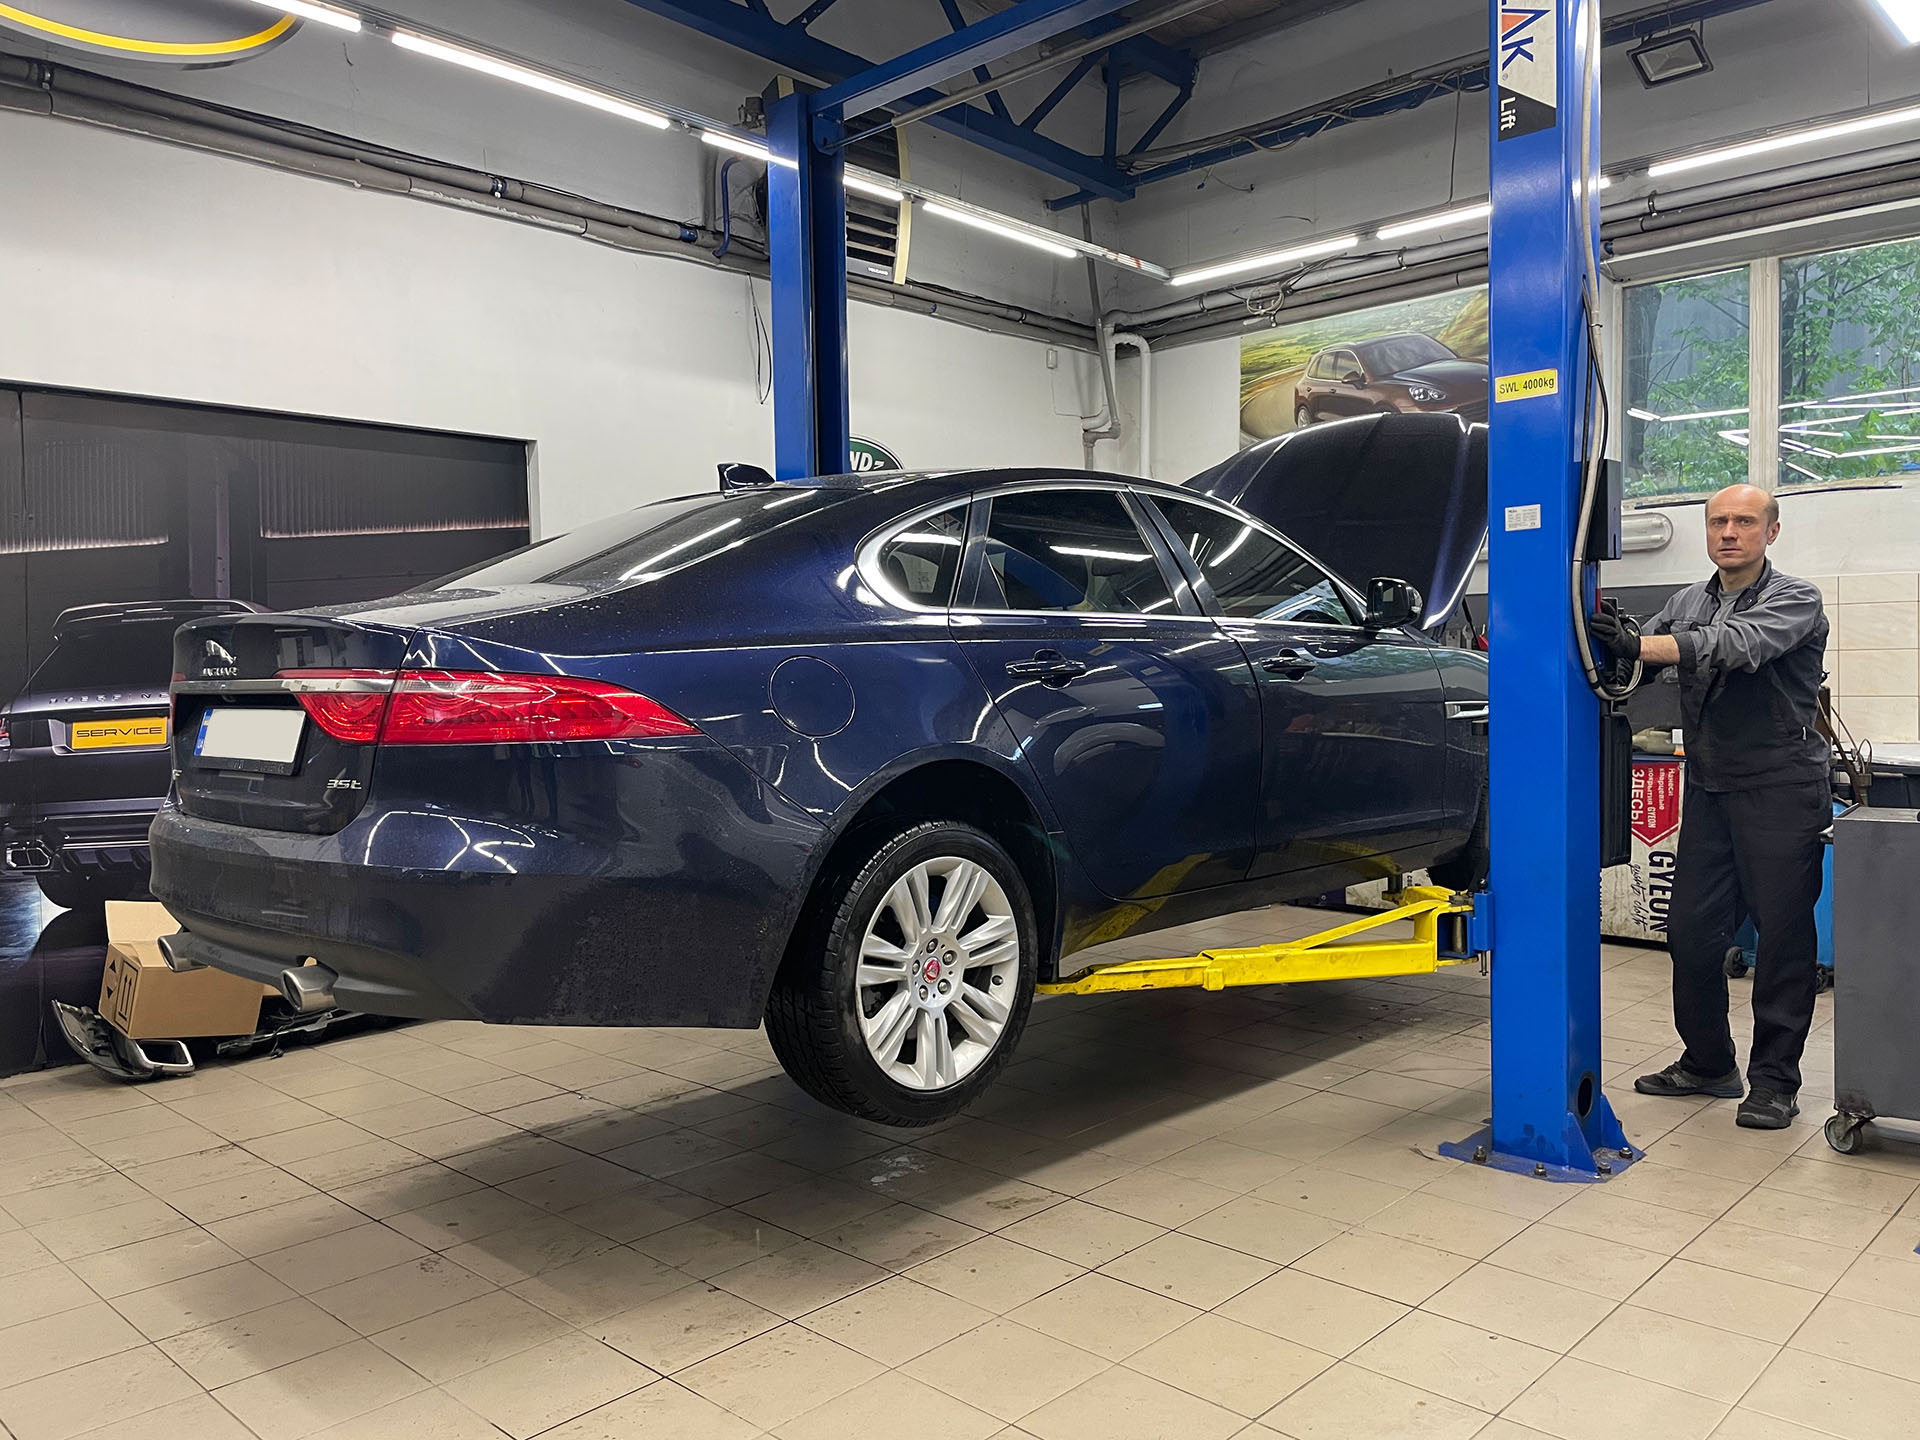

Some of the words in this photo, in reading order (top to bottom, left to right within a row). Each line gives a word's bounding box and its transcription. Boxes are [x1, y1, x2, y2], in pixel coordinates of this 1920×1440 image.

[1501, 0, 1551, 72] AK
[1500, 96, 1516, 131] Lift
[1499, 382, 1519, 394] SWL
[1523, 377, 1554, 390] 4000kg
[76, 727, 162, 737] SERVICE
[327, 779, 362, 789] 35t
[1632, 769, 1645, 825] ЗДЕСЬ!
[1647, 806, 1656, 829] GYEON
